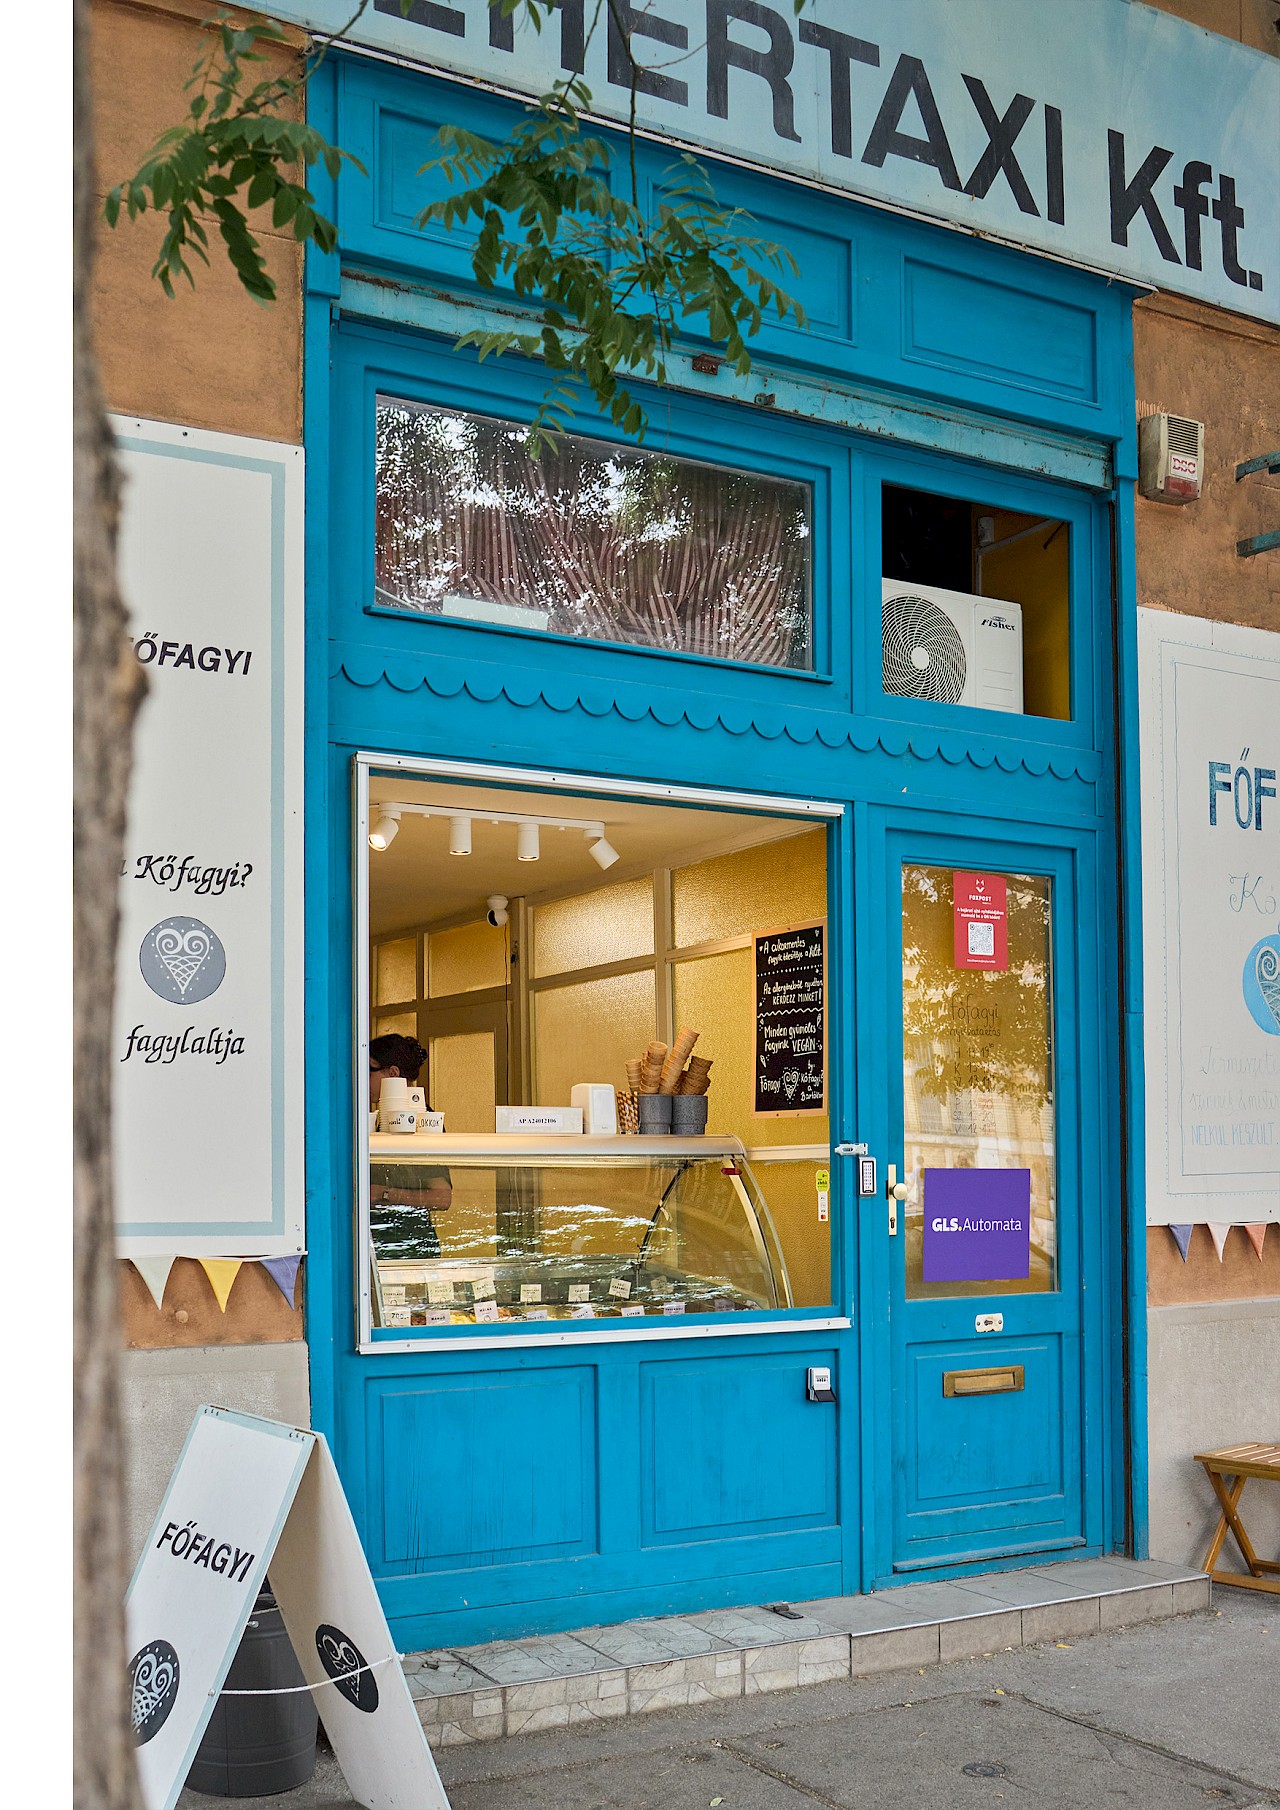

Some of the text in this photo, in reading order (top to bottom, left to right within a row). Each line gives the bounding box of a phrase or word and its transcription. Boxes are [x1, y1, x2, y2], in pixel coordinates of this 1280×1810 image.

[374, 0, 1263, 291] HERTAXI Kft.
[981, 618, 1016, 631] Fisher
[130, 631, 253, 675] ŐFAGYI
[1208, 746, 1277, 831] FŐF
[134, 855, 253, 895] Kőfagyi?
[969, 894, 992, 902] FOXPOST
[763, 941, 769, 954] A
[763, 982, 772, 995] Az
[764, 1023, 788, 1038] Minden
[120, 1024, 245, 1065] fagylaltja
[932, 1217, 1022, 1232] GLS.Automata
[156, 1520, 255, 1583] FŐFAGYI
